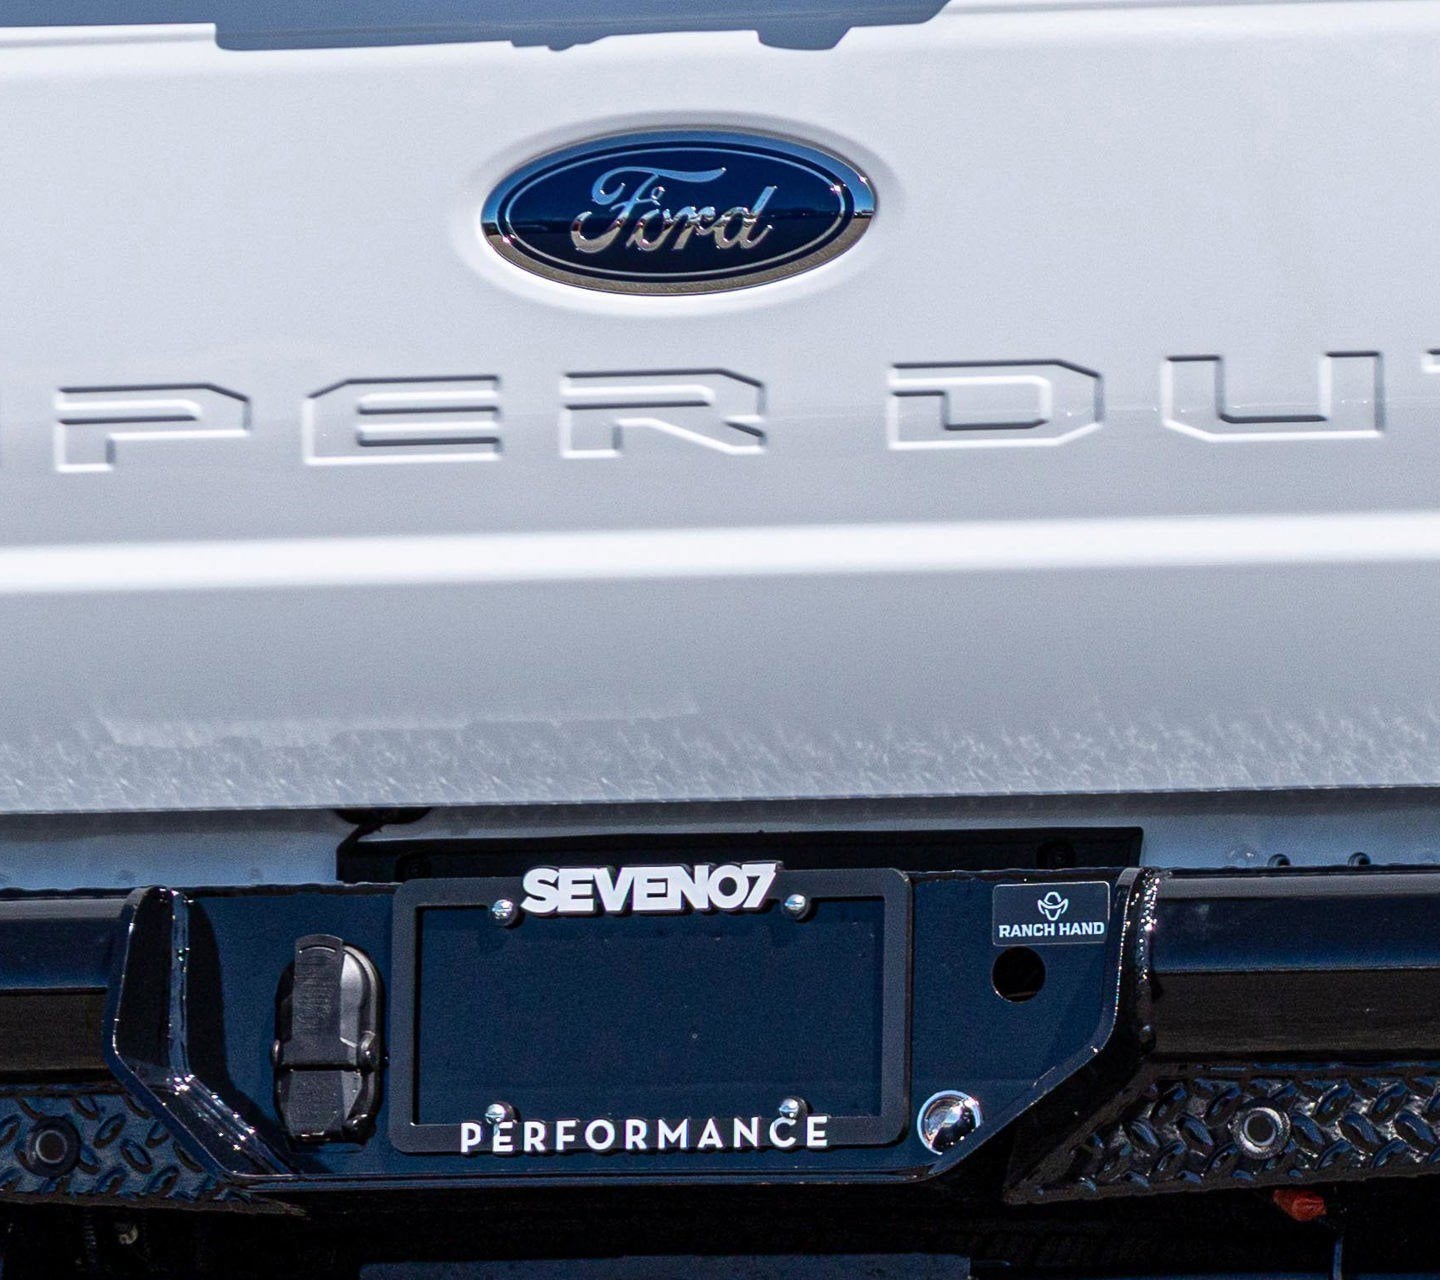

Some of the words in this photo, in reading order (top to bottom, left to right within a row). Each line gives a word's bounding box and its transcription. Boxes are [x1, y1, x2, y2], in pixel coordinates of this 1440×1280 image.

[570, 166, 778, 253] Ford
[998, 923, 1055, 938] RANCH
[1058, 921, 1105, 936] HAND
[460, 1115, 828, 1153] PERFORMANCE
